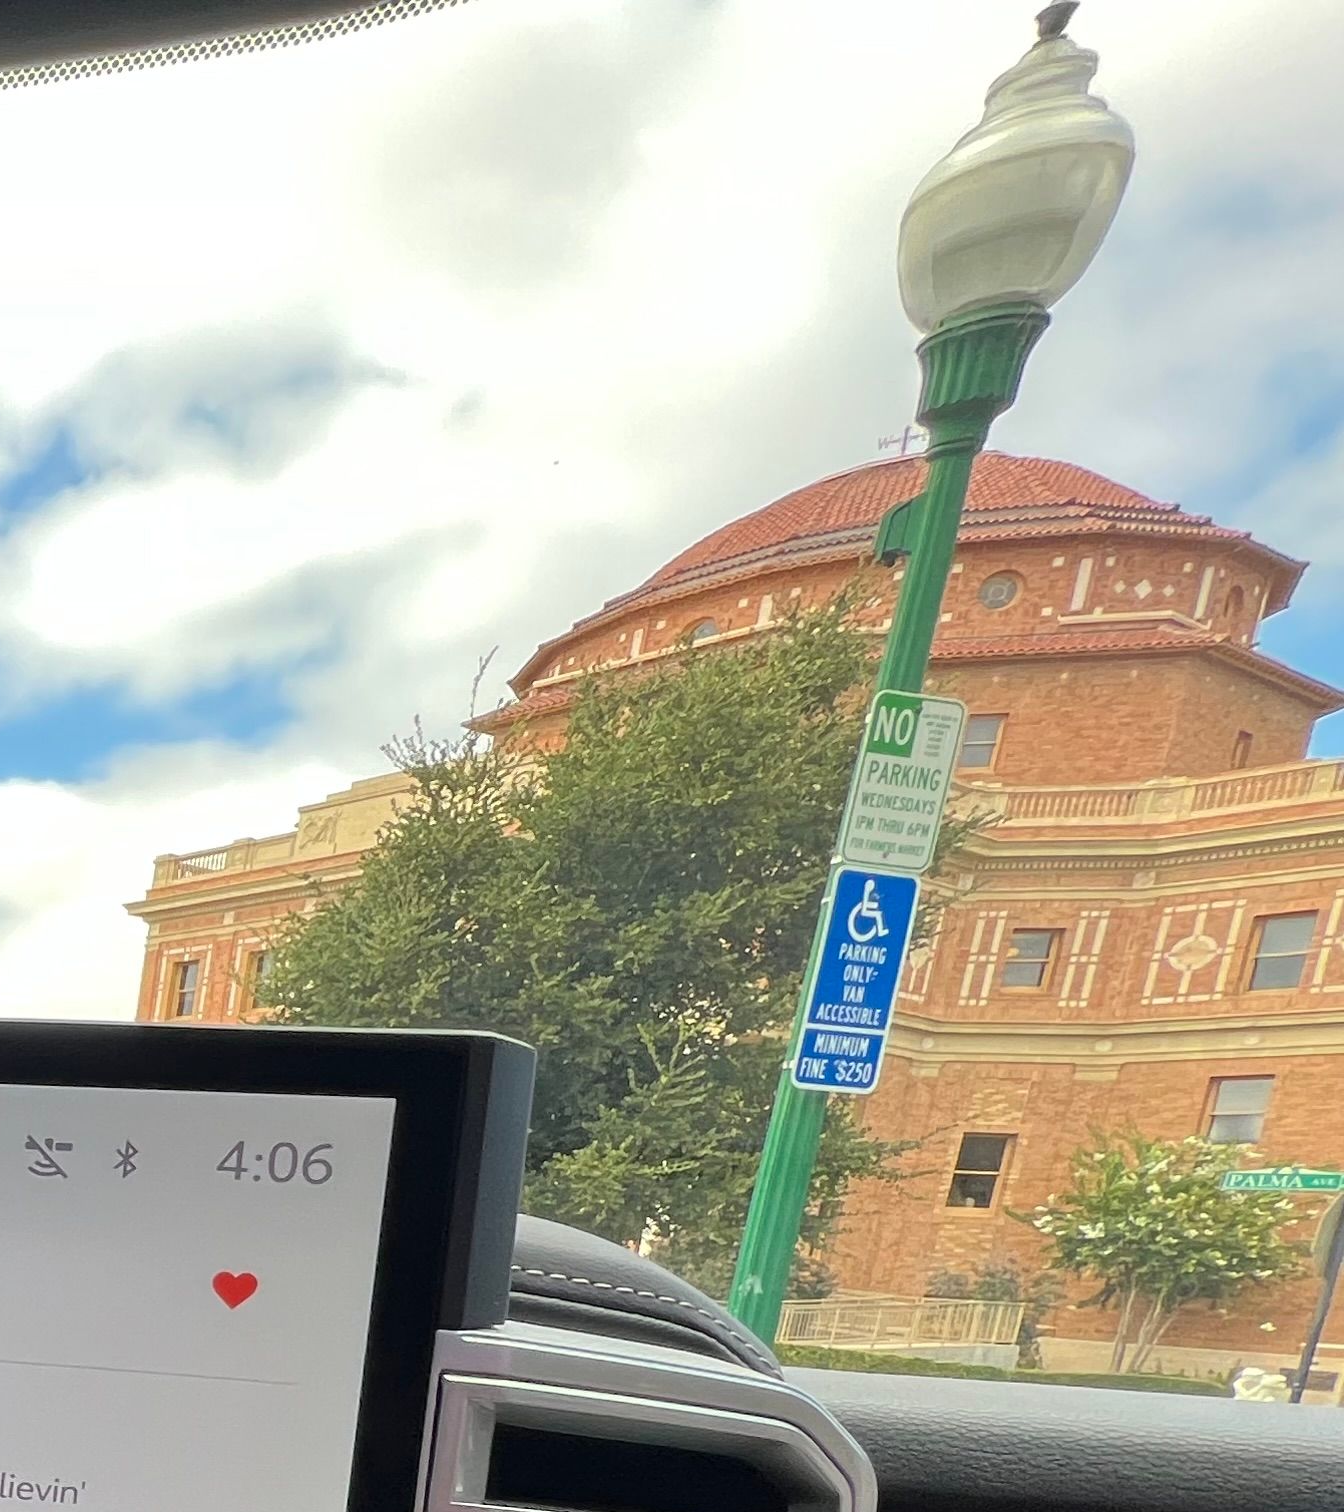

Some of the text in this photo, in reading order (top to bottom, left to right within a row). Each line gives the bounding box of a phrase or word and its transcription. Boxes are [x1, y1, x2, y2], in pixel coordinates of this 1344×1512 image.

[873, 705, 913, 746] NO
[866, 760, 942, 792] PARKING
[861, 791, 936, 816] WEDNESDAYS
[878, 817, 905, 834] THRU
[838, 942, 887, 964] PARKING
[843, 985, 865, 1003] VAN
[816, 1002, 881, 1026] ACCESSIBLE
[814, 1033, 870, 1058] MINIMUM
[799, 1057, 872, 1084] FINE $250
[216, 1140, 334, 1185] 4:06
[1228, 1174, 1304, 1188] PALMA
